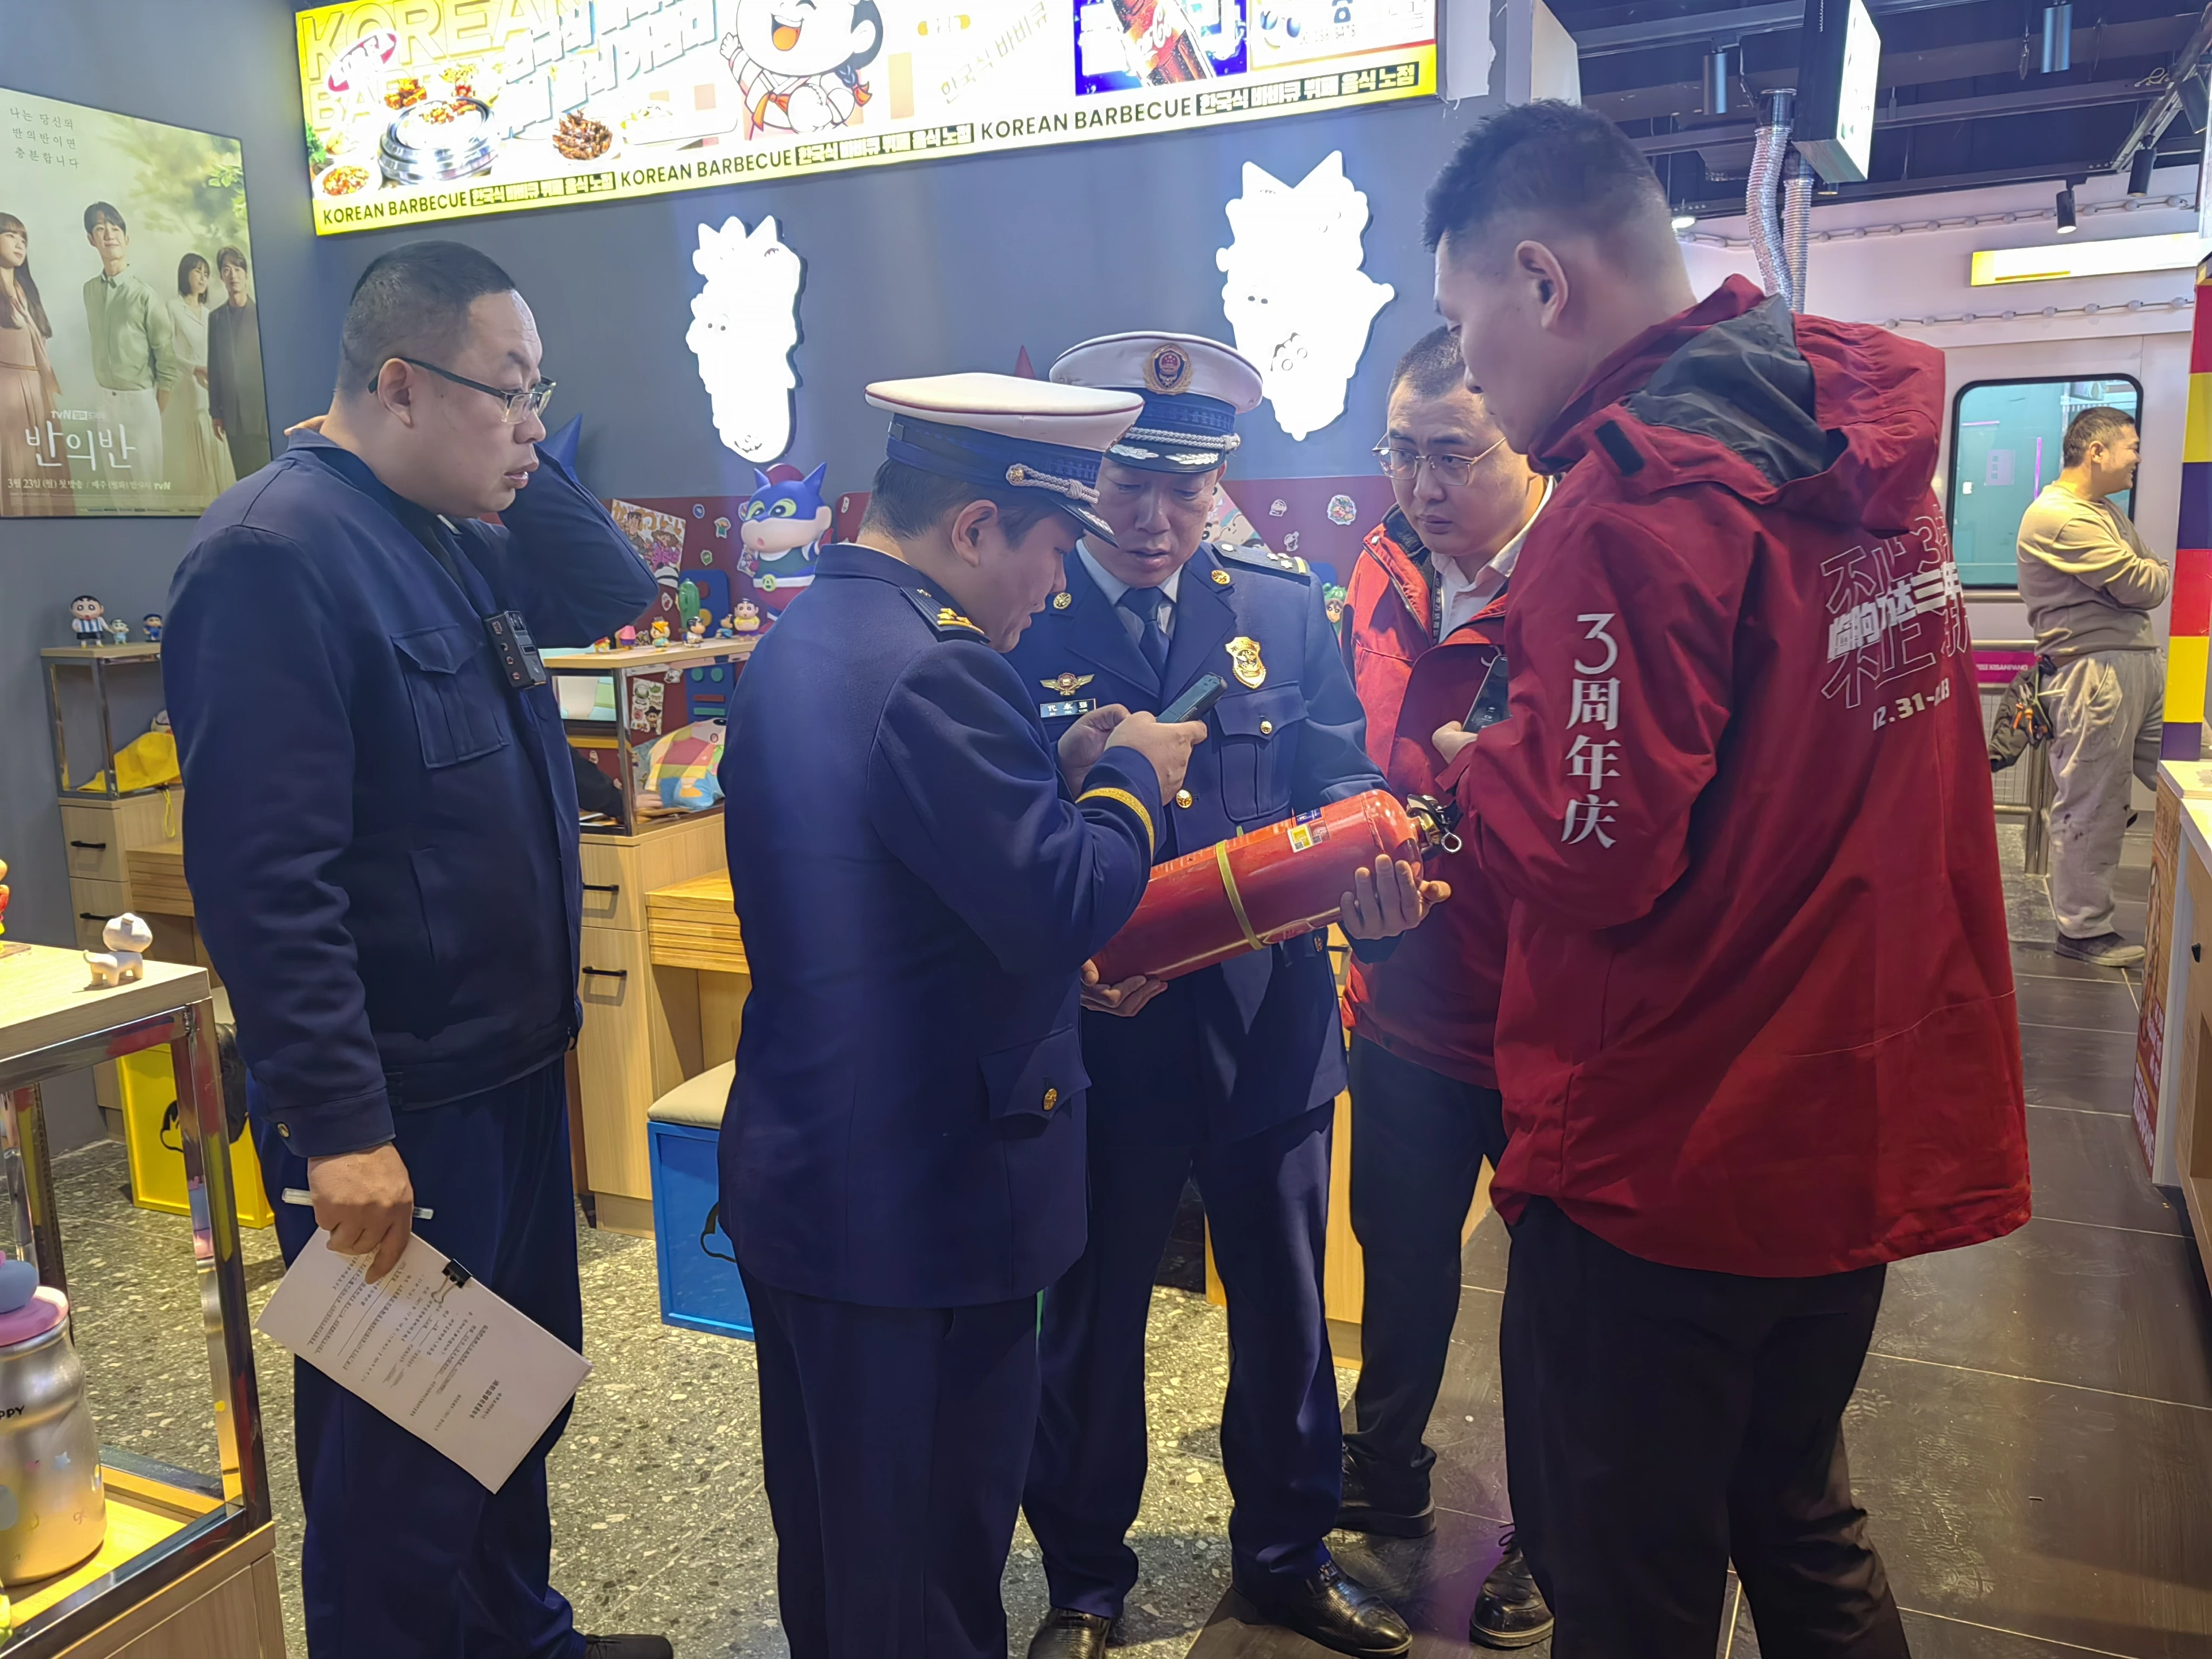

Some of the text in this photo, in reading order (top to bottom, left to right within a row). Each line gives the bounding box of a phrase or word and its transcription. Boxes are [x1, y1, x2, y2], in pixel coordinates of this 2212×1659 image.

[10, 107, 73, 131] 나는 당신의
[323, 202, 385, 225] KOREAN
[388, 191, 467, 216] BARBECUE
[621, 163, 692, 188] KOREAN
[697, 150, 792, 178] BARBECUE
[981, 113, 1068, 140] KOREAN
[1074, 97, 1191, 130] BARBECUE
[1199, 89, 1249, 116] 한국식
[1341, 70, 1377, 95] 음식
[1378, 64, 1415, 89] 노점
[15, 146, 79, 170] 충분합니다
[25, 420, 136, 471] 반의반
[1560, 613, 1622, 849] 3周年庆
